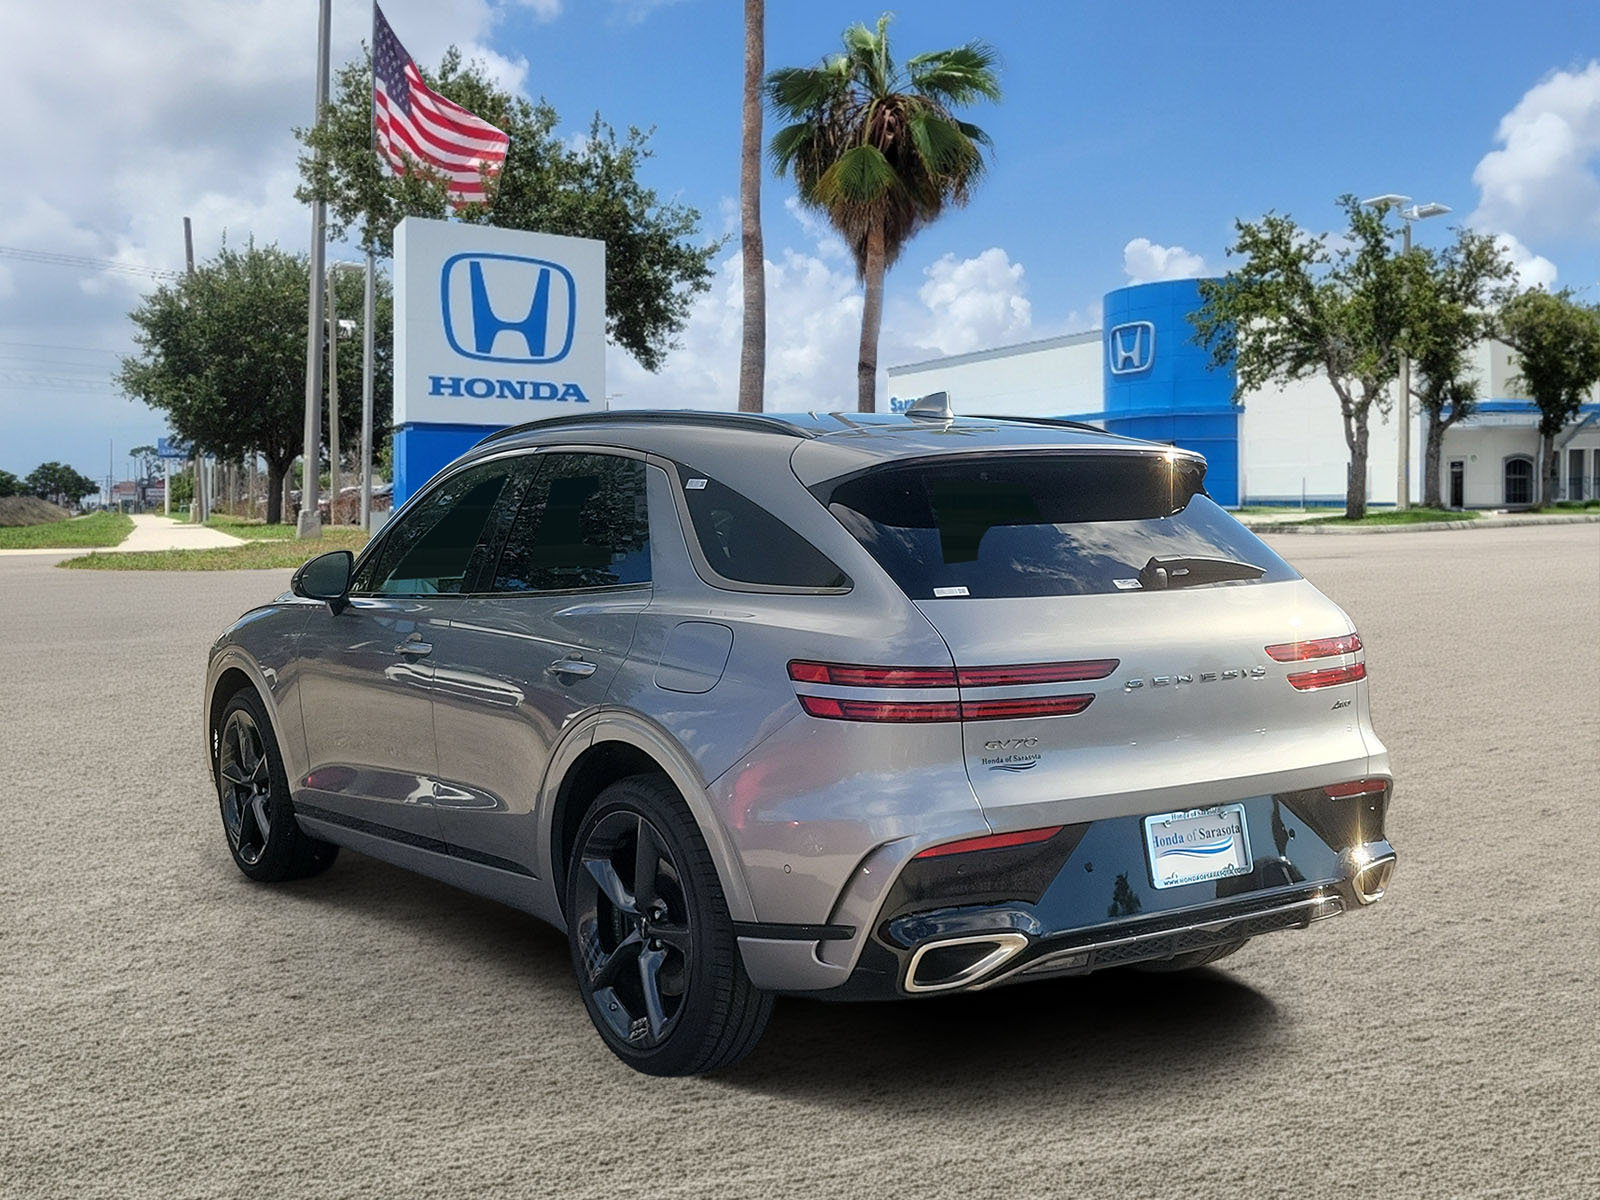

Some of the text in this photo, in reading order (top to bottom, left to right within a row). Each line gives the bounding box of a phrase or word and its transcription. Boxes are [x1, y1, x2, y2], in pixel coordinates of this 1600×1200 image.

[428, 375, 590, 403] HONDA
[1124, 665, 1267, 690] GENESIS
[984, 736, 1039, 751] GV70
[981, 756, 1004, 766] Honda
[1004, 755, 1012, 763] of
[1187, 829, 1198, 842] of
[1198, 823, 1241, 840] Sarasota
